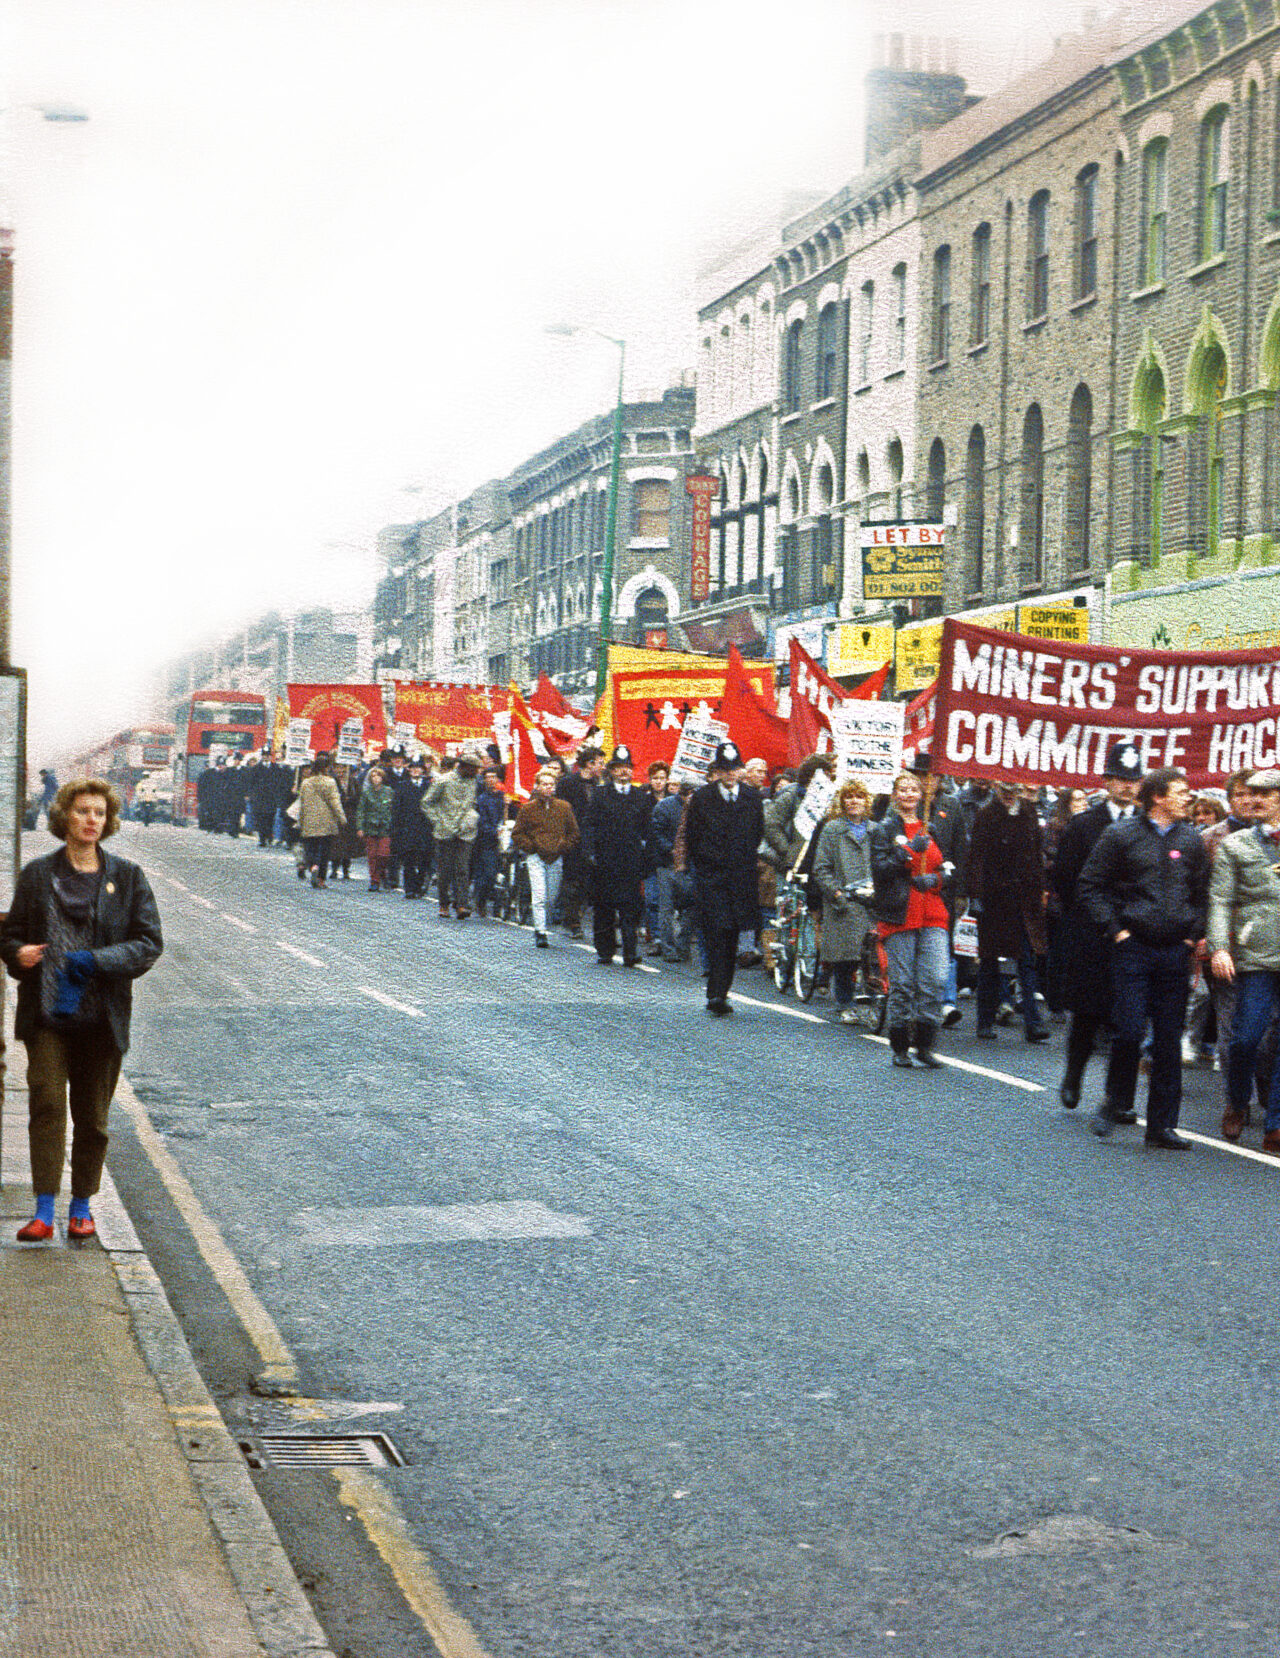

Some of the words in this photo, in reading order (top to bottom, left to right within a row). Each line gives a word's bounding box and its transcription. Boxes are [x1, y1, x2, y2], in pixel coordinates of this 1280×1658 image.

[873, 528, 910, 544] LET
[919, 528, 945, 544] BY
[1031, 611, 1077, 624] COPYING
[1027, 626, 1079, 639] PRINTING
[951, 638, 1131, 710] MINERS'
[844, 720, 897, 731] VICTORY
[868, 740, 892, 752] THE
[847, 758, 894, 770] MINERS
